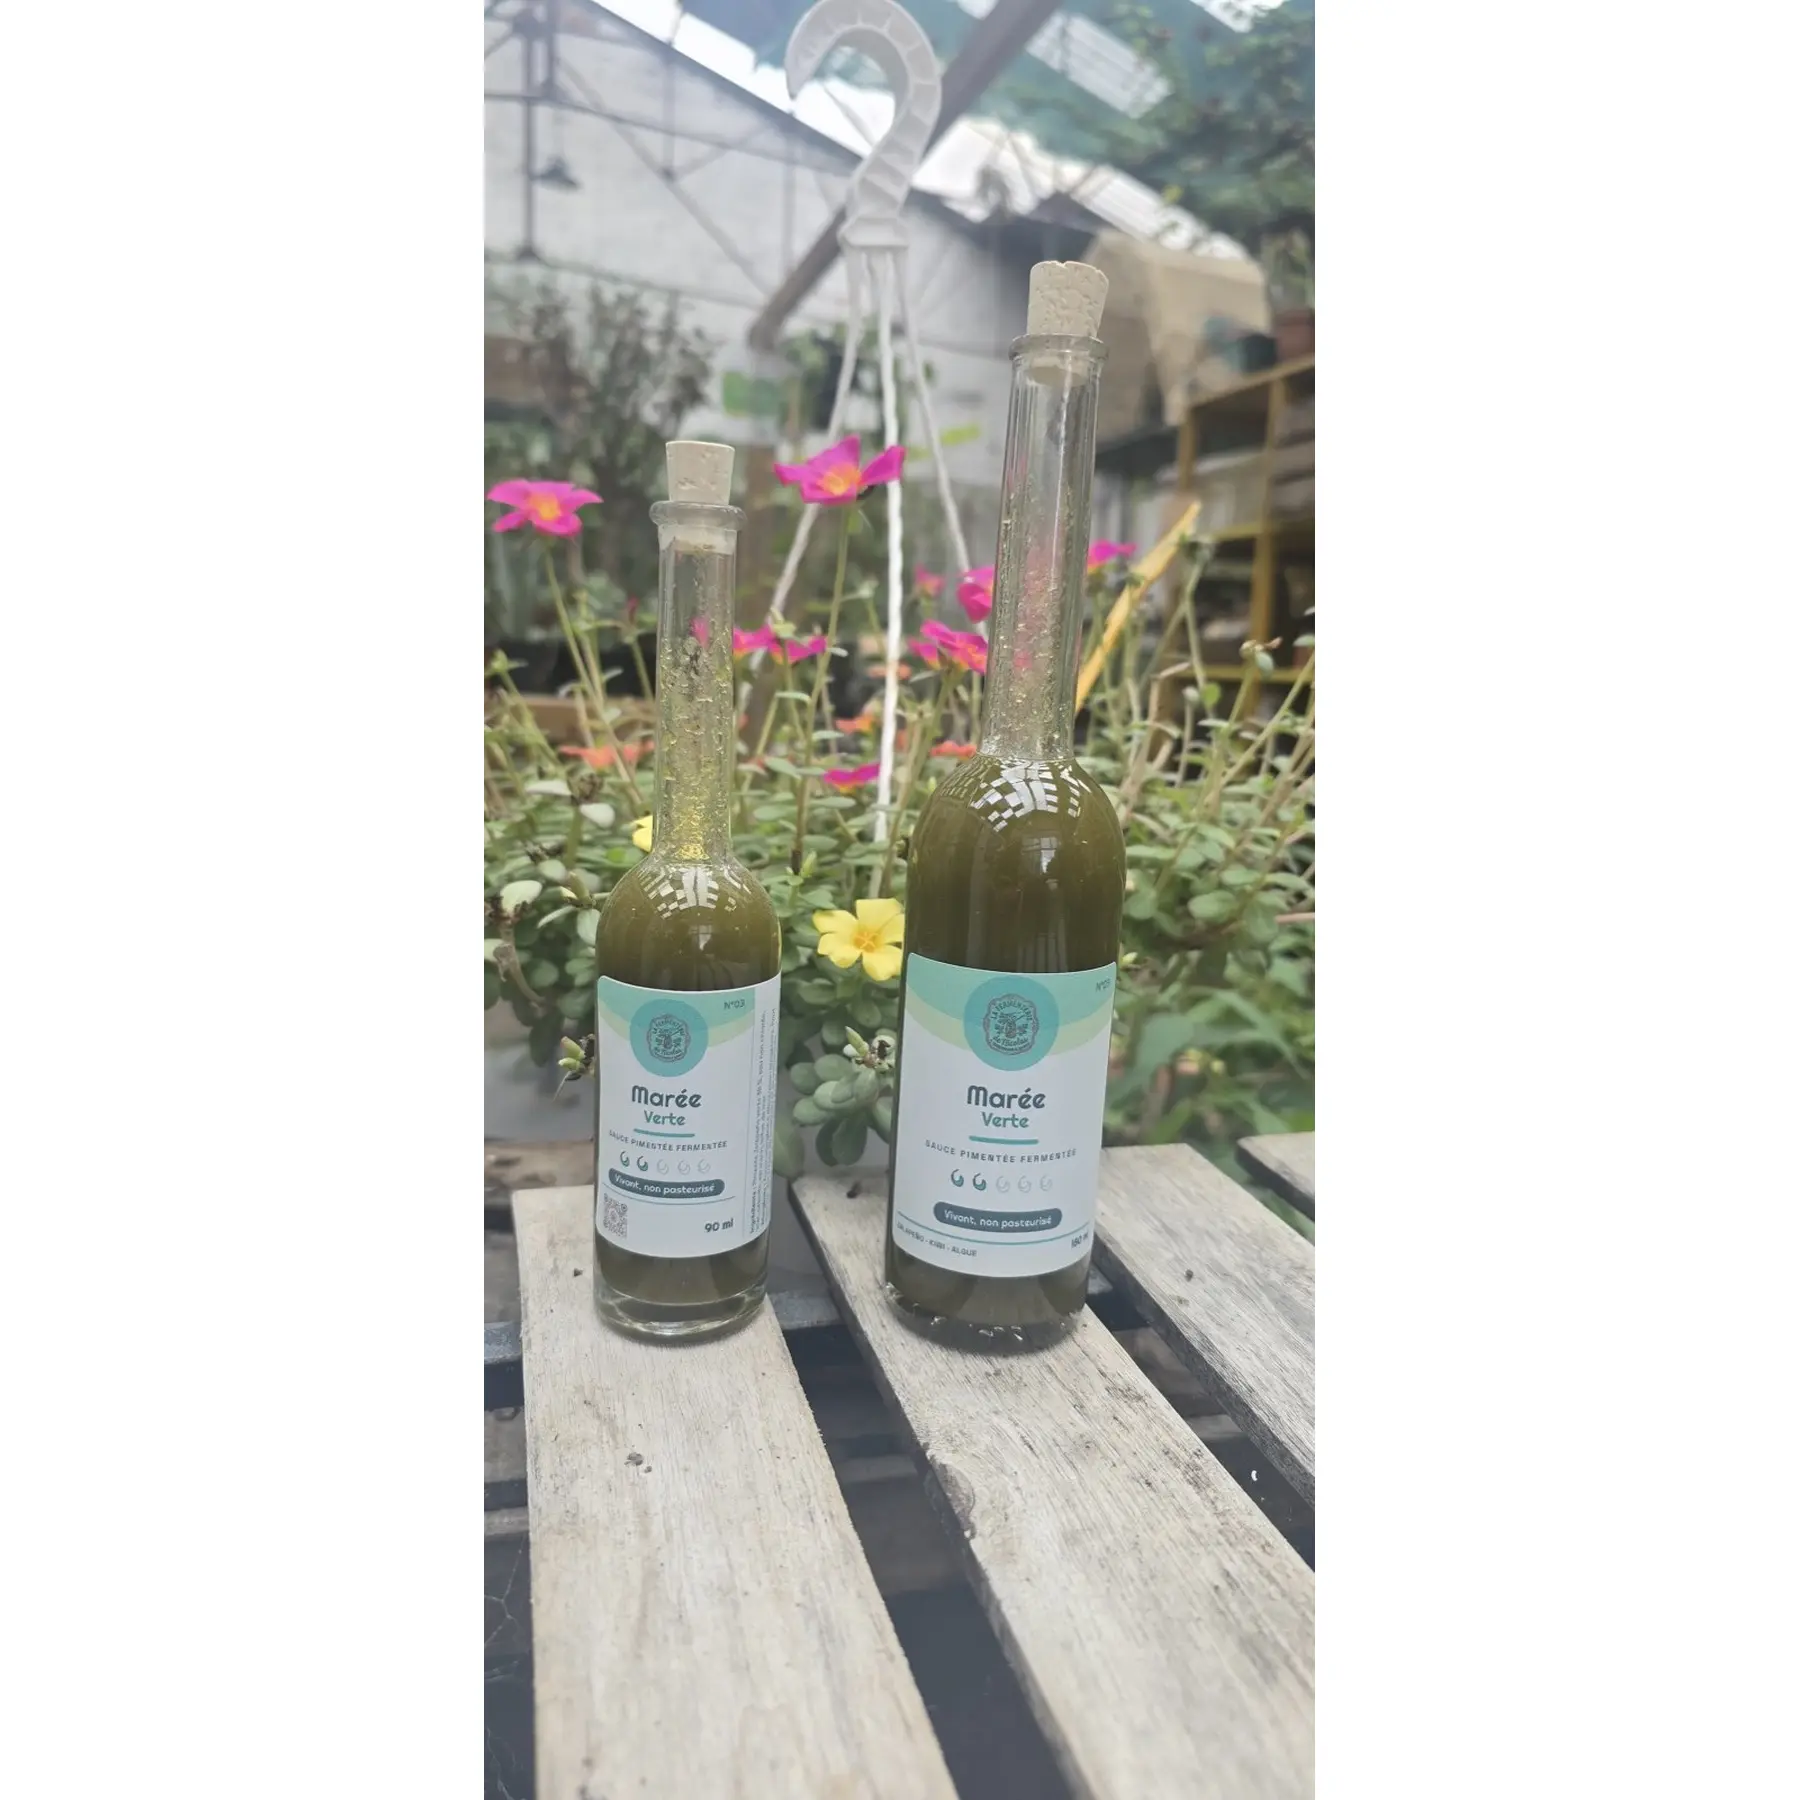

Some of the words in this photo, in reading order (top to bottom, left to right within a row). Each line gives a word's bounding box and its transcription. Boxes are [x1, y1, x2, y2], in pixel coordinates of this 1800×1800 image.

[724, 999, 746, 1010] N°03
[632, 1085, 702, 1108] Marée
[967, 1085, 1046, 1109] Marée
[643, 1110, 686, 1126] Verte
[981, 1111, 1029, 1128] Verte
[609, 1129, 629, 1144] SAUCE
[631, 1139, 674, 1152] PIMENTÉE
[676, 1140, 728, 1152] FERMENTÉE
[925, 1139, 955, 1155] SAUCE
[960, 1149, 1016, 1163] PIMENTÉE
[1020, 1148, 1077, 1163] FERMENTÉE
[614, 1173, 642, 1191] Vivant,
[643, 1184, 661, 1193] non
[663, 1183, 716, 1195] pasteurisé
[704, 1222, 720, 1233] 90
[722, 1218, 734, 1230] ml
[944, 1209, 977, 1225] Vivant,
[979, 1217, 999, 1227] non
[1001, 1215, 1052, 1230] pasteurisé
[951, 1246, 978, 1257] ALGUE
